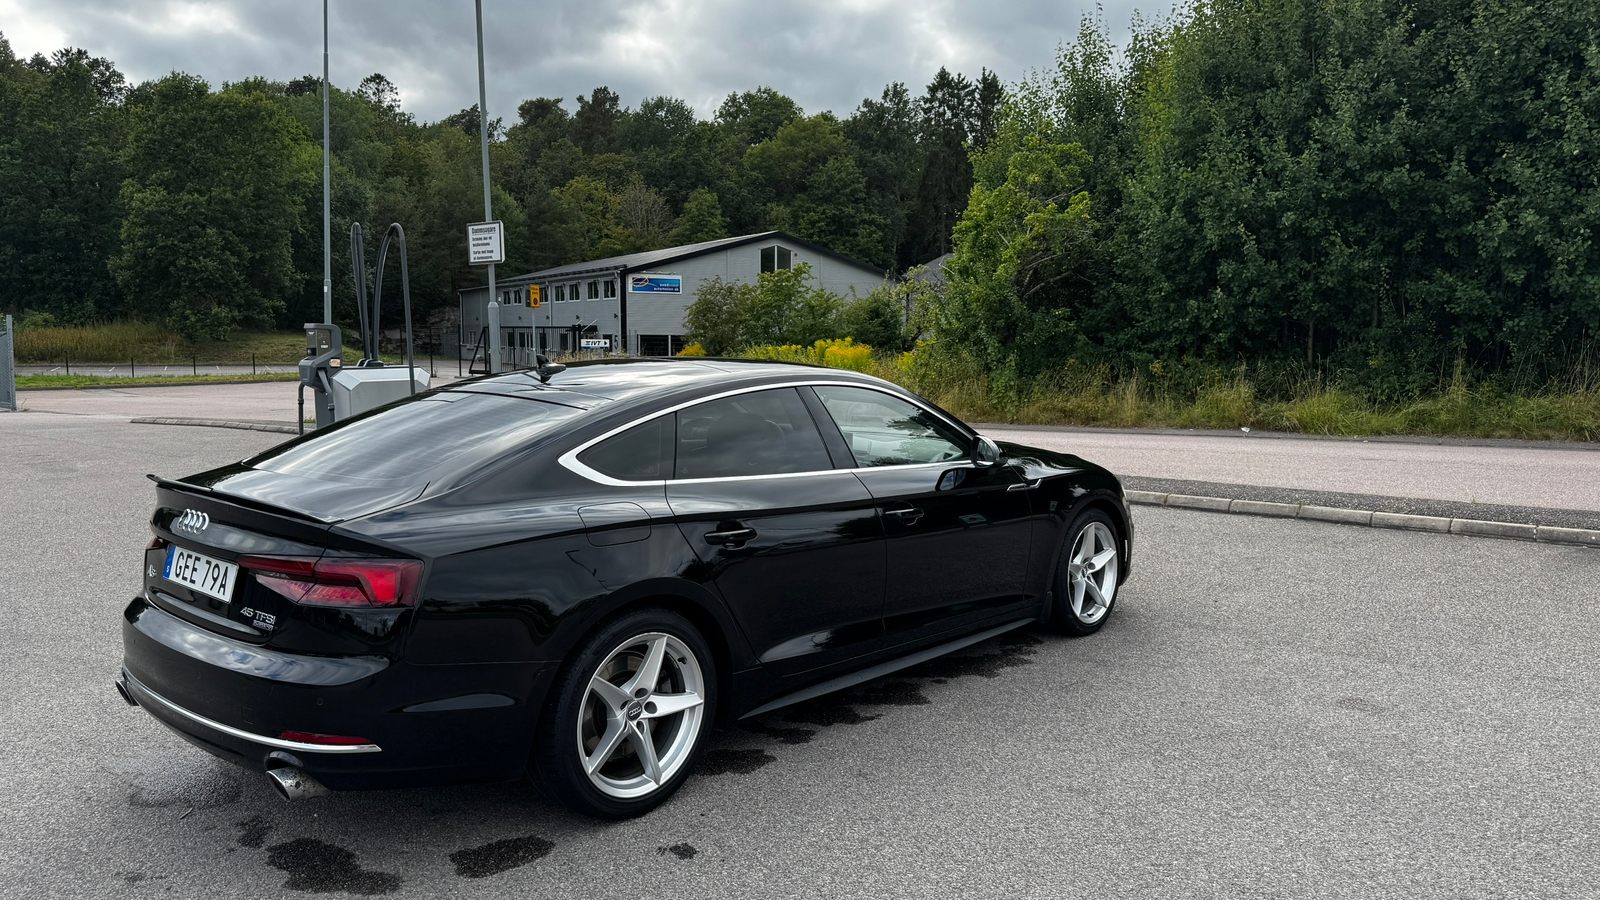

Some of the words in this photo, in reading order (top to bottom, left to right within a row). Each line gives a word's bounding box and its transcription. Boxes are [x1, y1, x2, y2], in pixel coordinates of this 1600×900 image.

[174, 551, 201, 585] GEE
[201, 560, 229, 596] 79A
[240, 606, 254, 618] 45
[255, 610, 276, 624] TFSI
